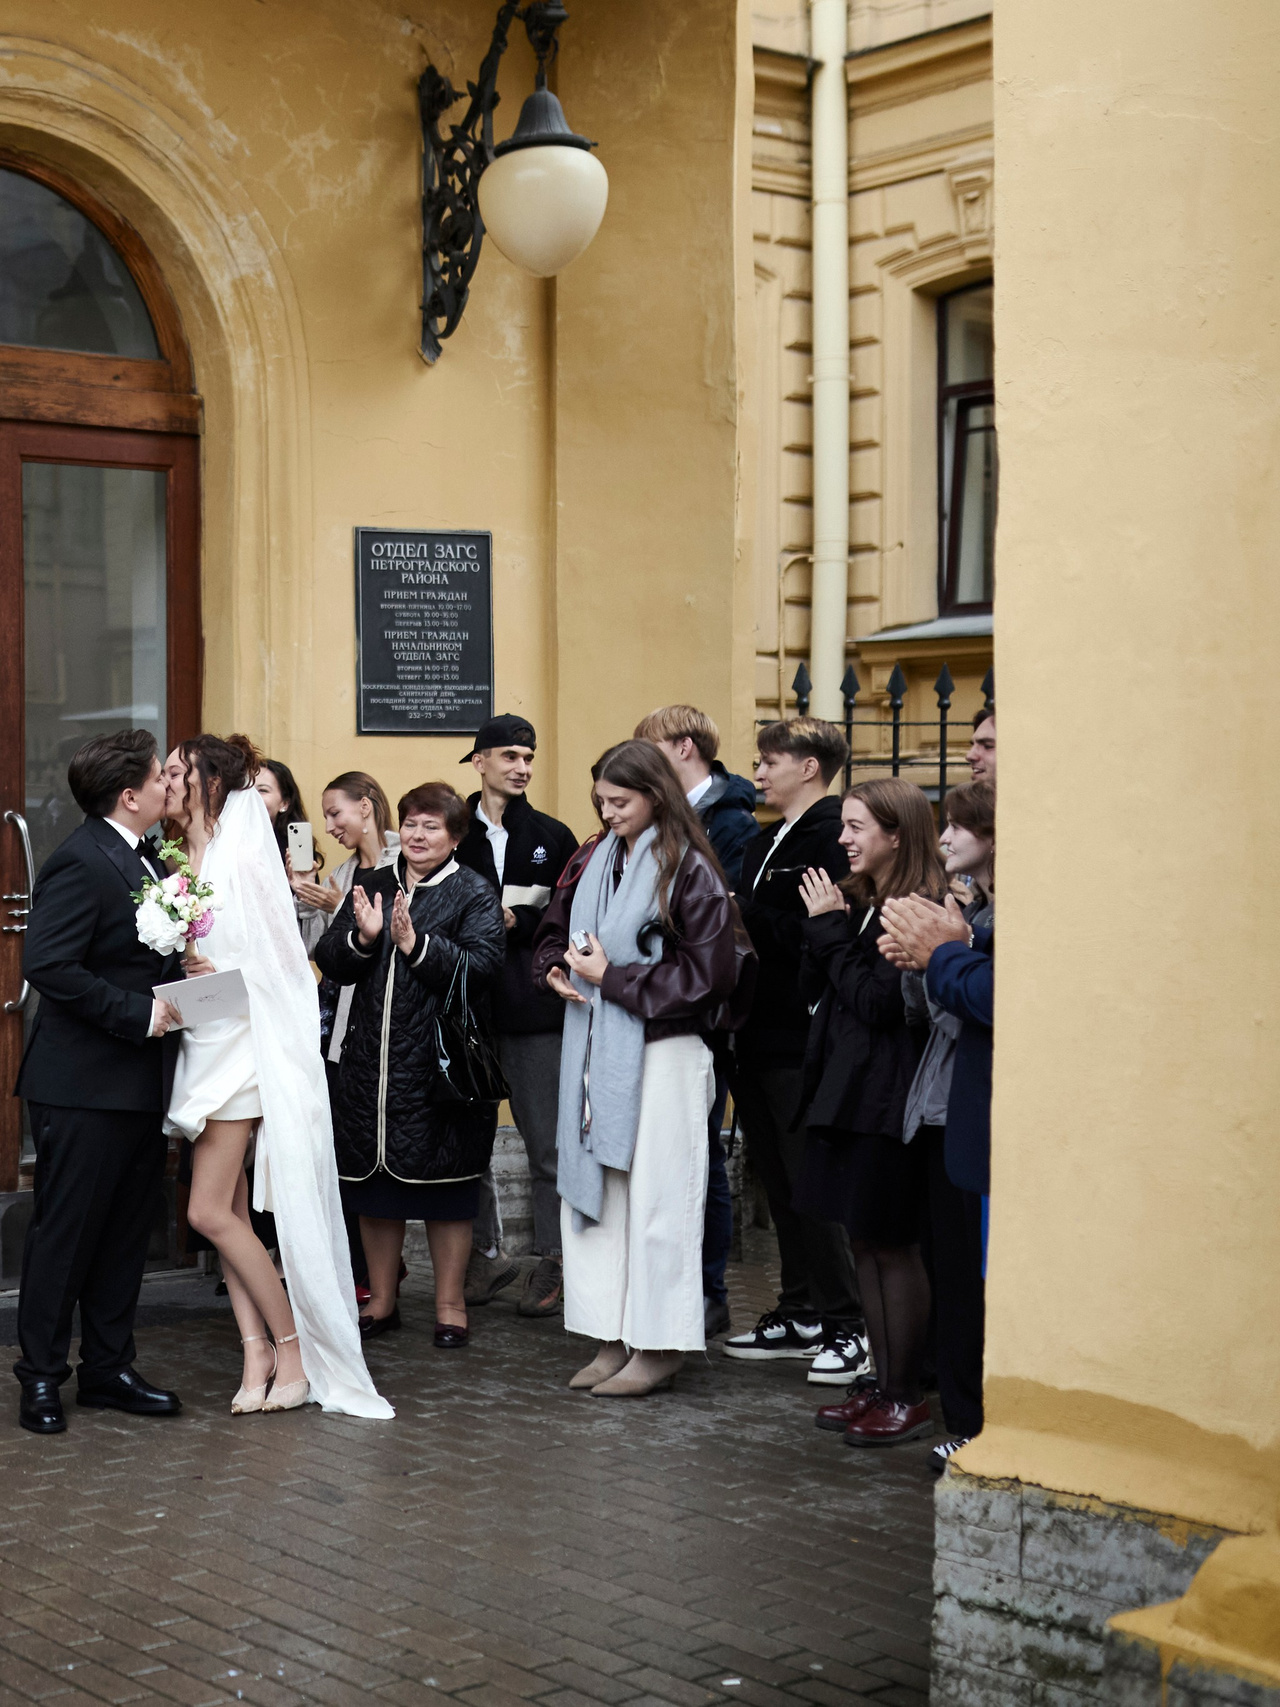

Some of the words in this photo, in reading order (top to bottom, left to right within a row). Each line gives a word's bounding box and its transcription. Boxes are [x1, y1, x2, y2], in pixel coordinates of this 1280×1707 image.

[371, 542, 428, 560] ОТДЕЛ
[434, 544, 478, 560] ЗАГС
[370, 560, 480, 573] ПЕТРОГРАДСКОГО
[401, 572, 450, 585] РАЙОНА
[384, 590, 418, 600] ПРИЕМ
[420, 591, 468, 602] ГРАЖДАН
[384, 630, 418, 640] ПРИЕМ
[421, 632, 470, 641] ГРАЖДАН
[392, 642, 462, 652] НАЧАЛЬНИКОМ
[394, 652, 432, 662] ОТДЕЛА
[436, 652, 460, 661] ЗАГС
